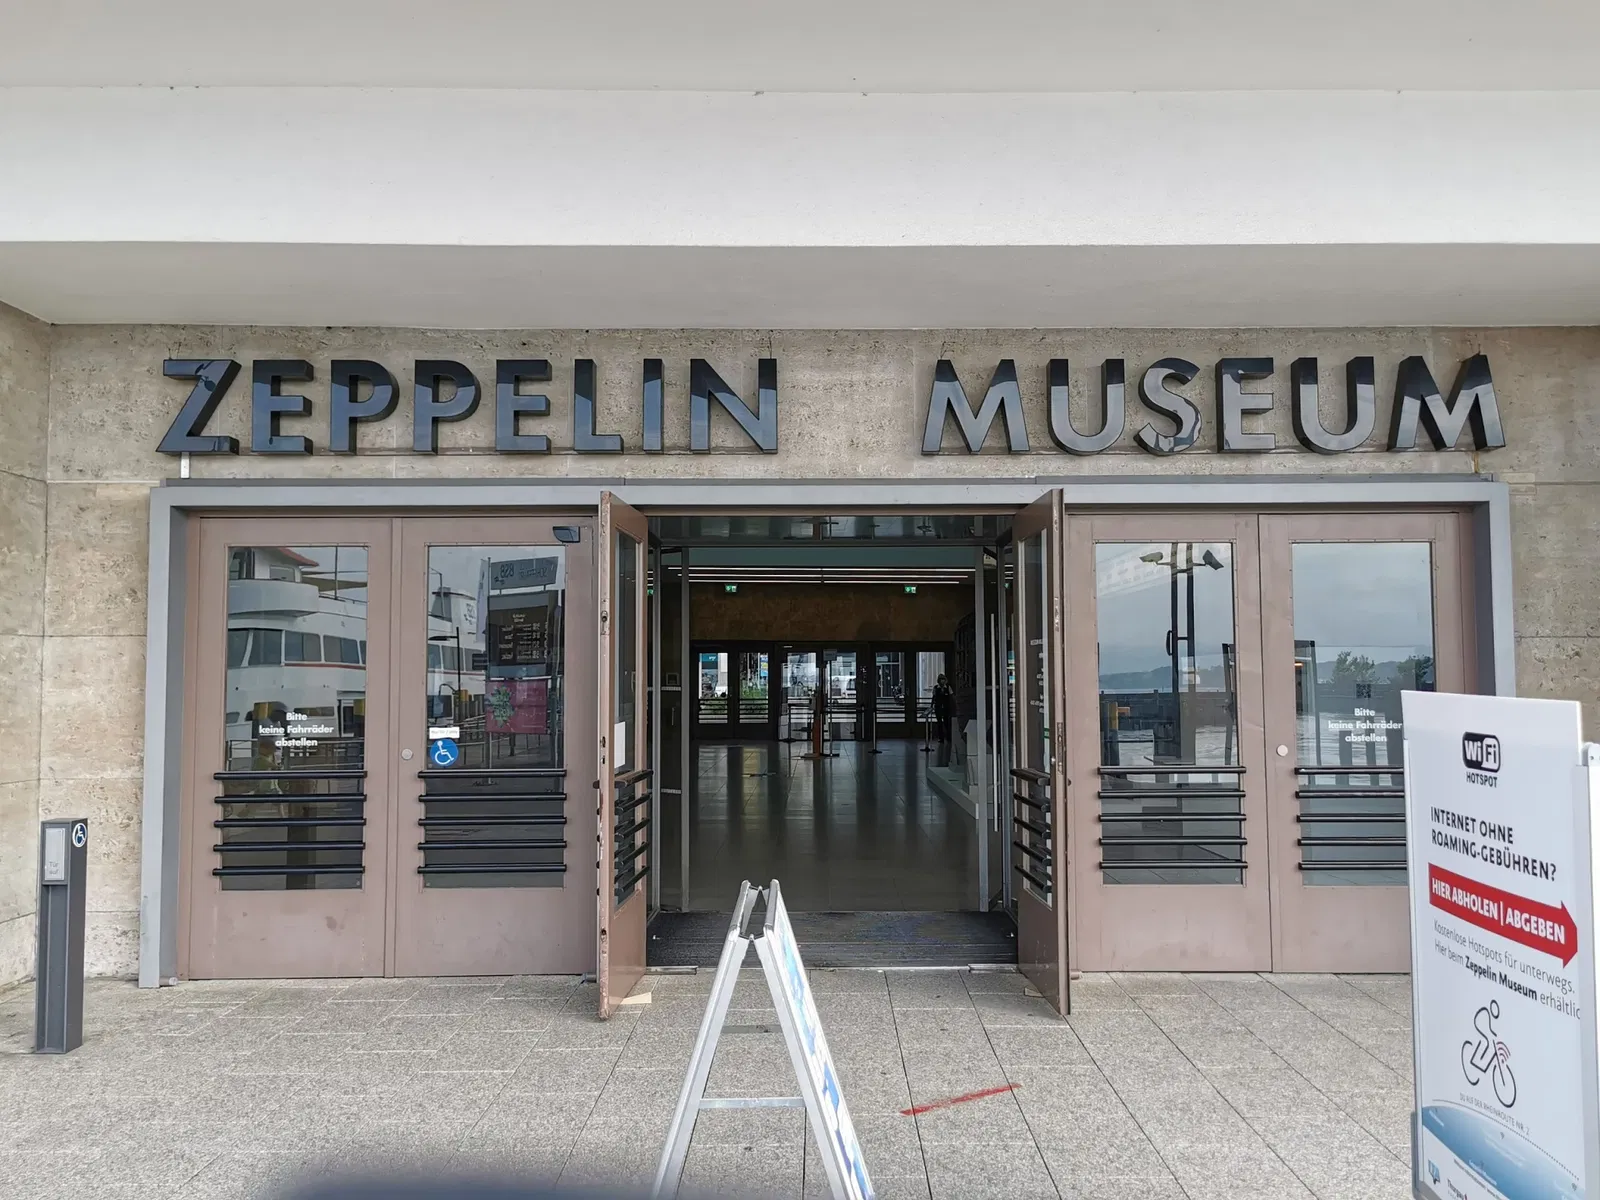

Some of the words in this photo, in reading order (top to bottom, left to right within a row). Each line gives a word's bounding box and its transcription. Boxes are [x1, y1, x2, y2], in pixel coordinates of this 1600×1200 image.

[155, 358, 779, 455] ZEPPELIN
[921, 354, 1506, 456] MUSEUM
[286, 712, 308, 720] Bitte
[1354, 708, 1375, 716] Bitte
[259, 725, 285, 734] keine
[287, 724, 334, 733] Fahrräder
[1328, 720, 1353, 729] keine
[1356, 720, 1402, 729] Fahrräder
[275, 737, 318, 746] abstellen
[1345, 733, 1387, 742] abstellen
[1466, 772, 1498, 788] HOTSPOT
[1430, 806, 1476, 834] INTERNET
[1479, 820, 1514, 845] OHNE
[1431, 828, 1557, 882] ROAMING-GEBÜHREN?
[1432, 877, 1451, 901] HIER
[1452, 889, 1498, 920] ABHOLEN
[1505, 907, 1565, 944] ABGEBEN
[1433, 919, 1467, 947] Kostenlose
[1468, 936, 1503, 964] Hotspots
[1504, 950, 1517, 969] für
[1519, 961, 1575, 996] unterwegs.
[1434, 939, 1447, 957] Hier
[1447, 945, 1464, 966] beim
[1465, 955, 1497, 982] Zeppelin
[1498, 971, 1538, 1001] Museum
